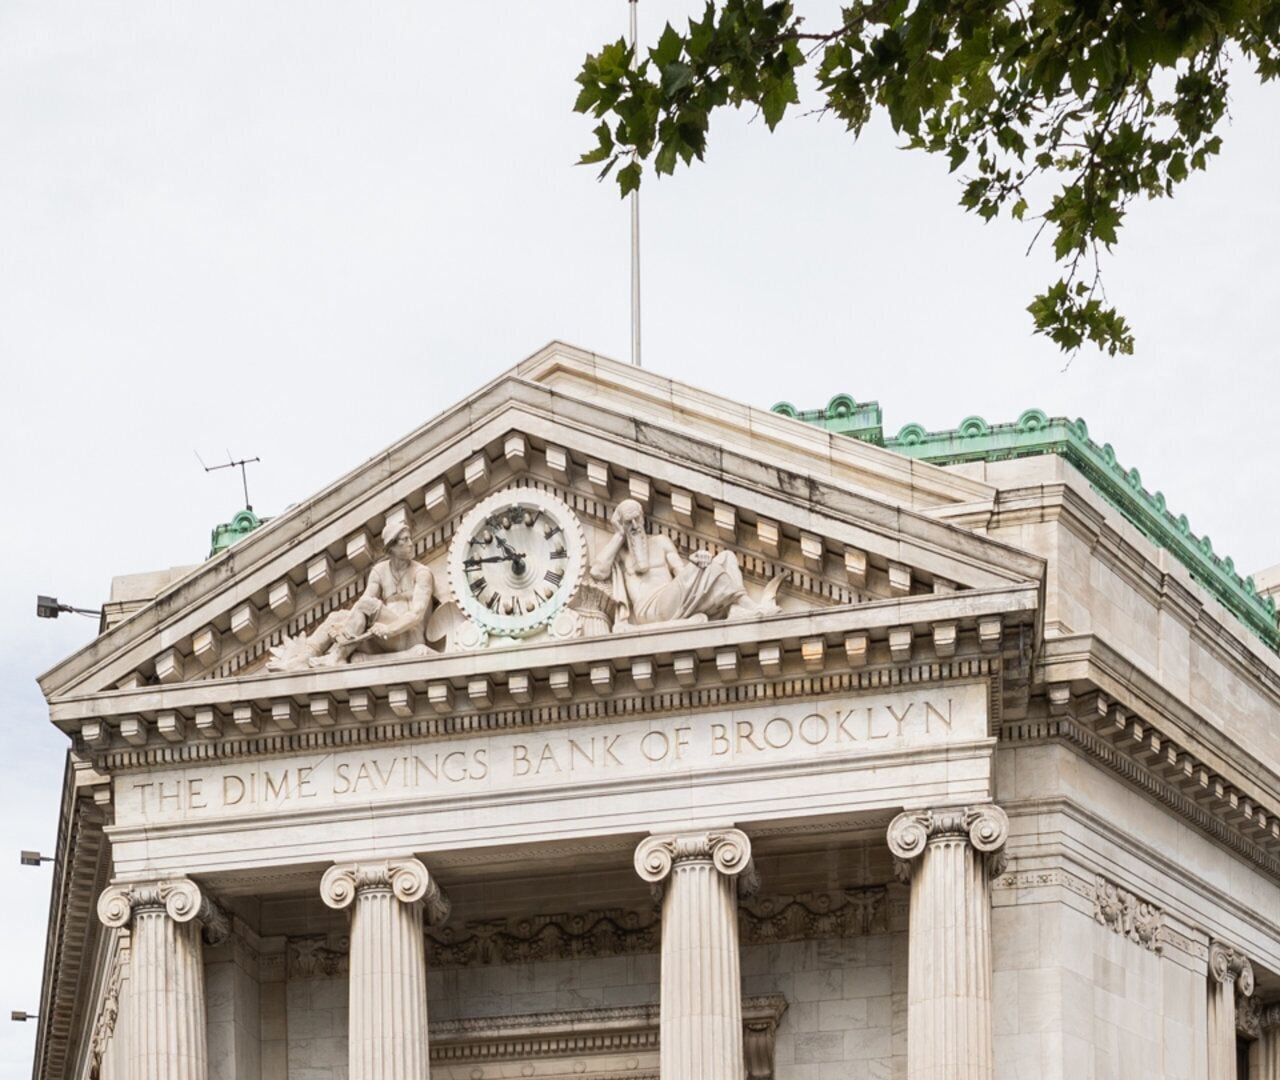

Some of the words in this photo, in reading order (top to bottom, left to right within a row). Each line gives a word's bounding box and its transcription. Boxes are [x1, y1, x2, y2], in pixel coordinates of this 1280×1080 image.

[133, 778, 207, 815] THE
[222, 766, 318, 807] DIME
[332, 749, 488, 795] SAVINGS
[512, 734, 624, 778] BANK
[640, 726, 692, 762] OF
[710, 699, 954, 757] BROOKLYN
